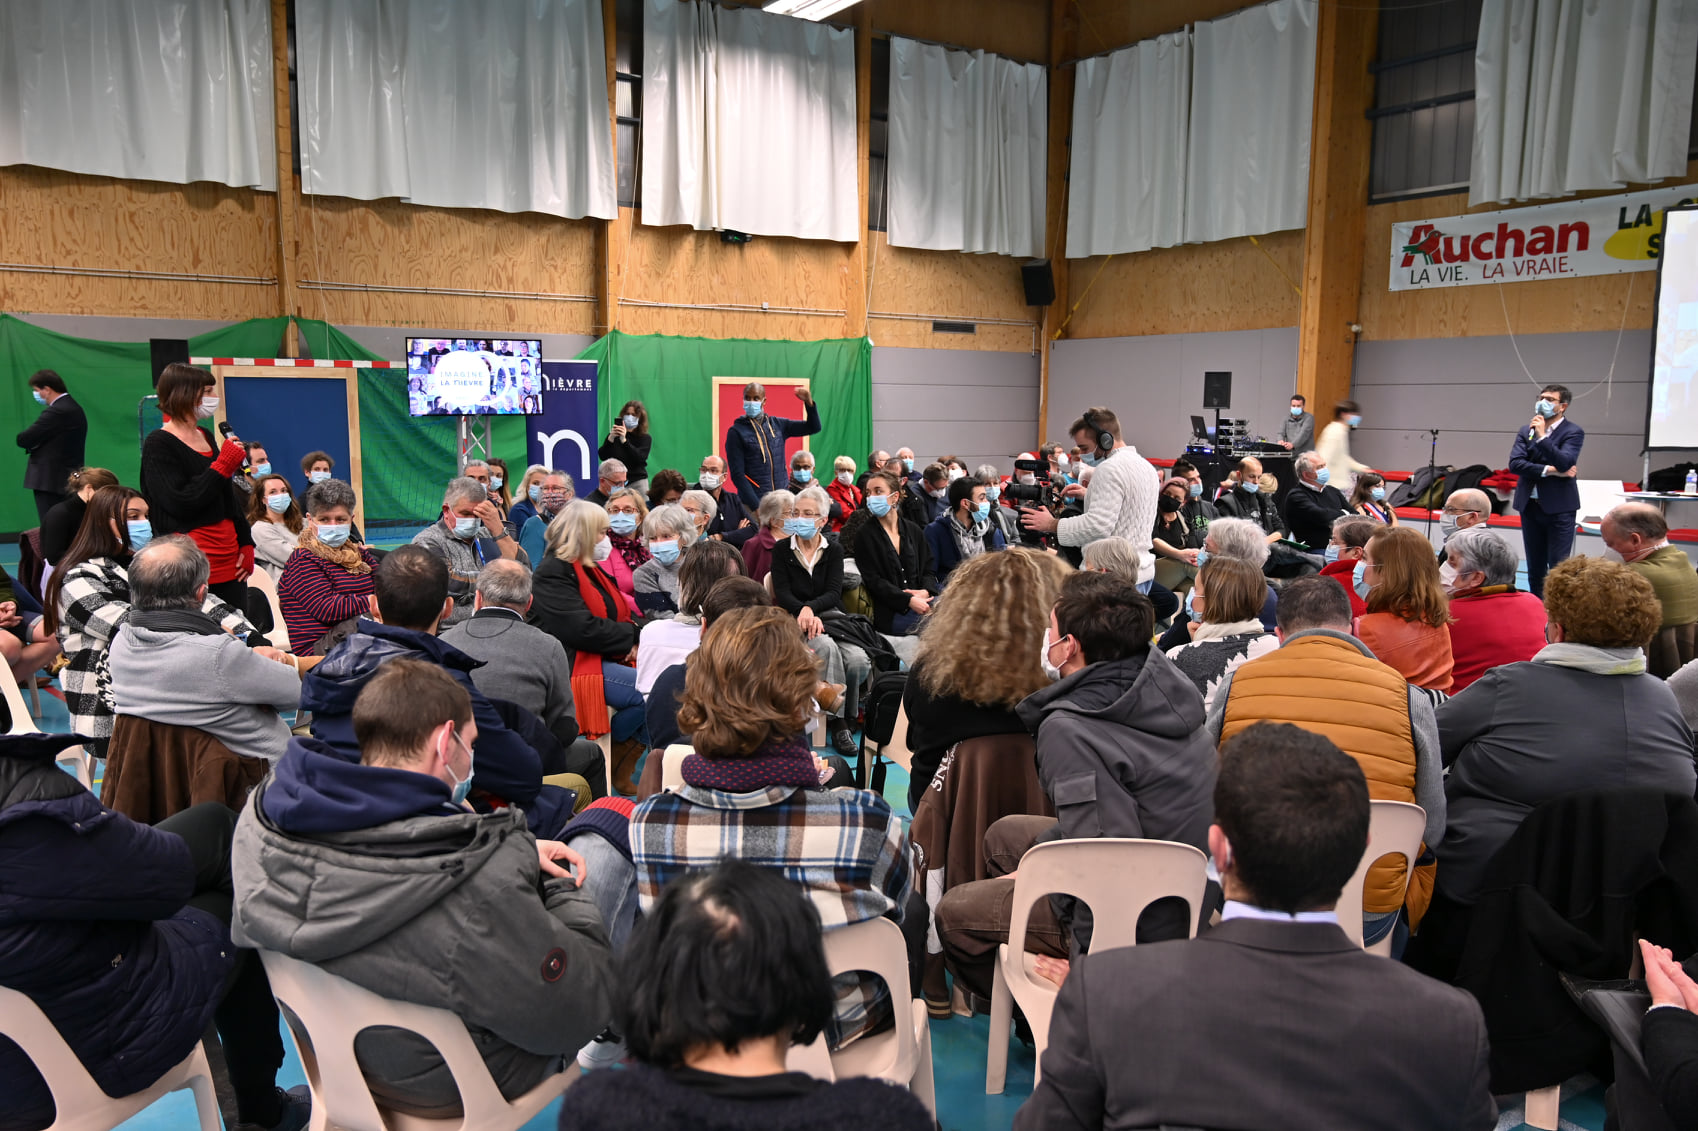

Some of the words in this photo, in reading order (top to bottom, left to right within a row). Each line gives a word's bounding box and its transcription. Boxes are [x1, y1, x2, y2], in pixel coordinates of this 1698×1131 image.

[1618, 203, 1653, 230] LA
[1401, 221, 1590, 267] Auchan
[1410, 268, 1430, 285] LA
[1437, 265, 1468, 282] VIE.
[1483, 262, 1504, 279] LA
[1513, 256, 1574, 276] VRAIE.
